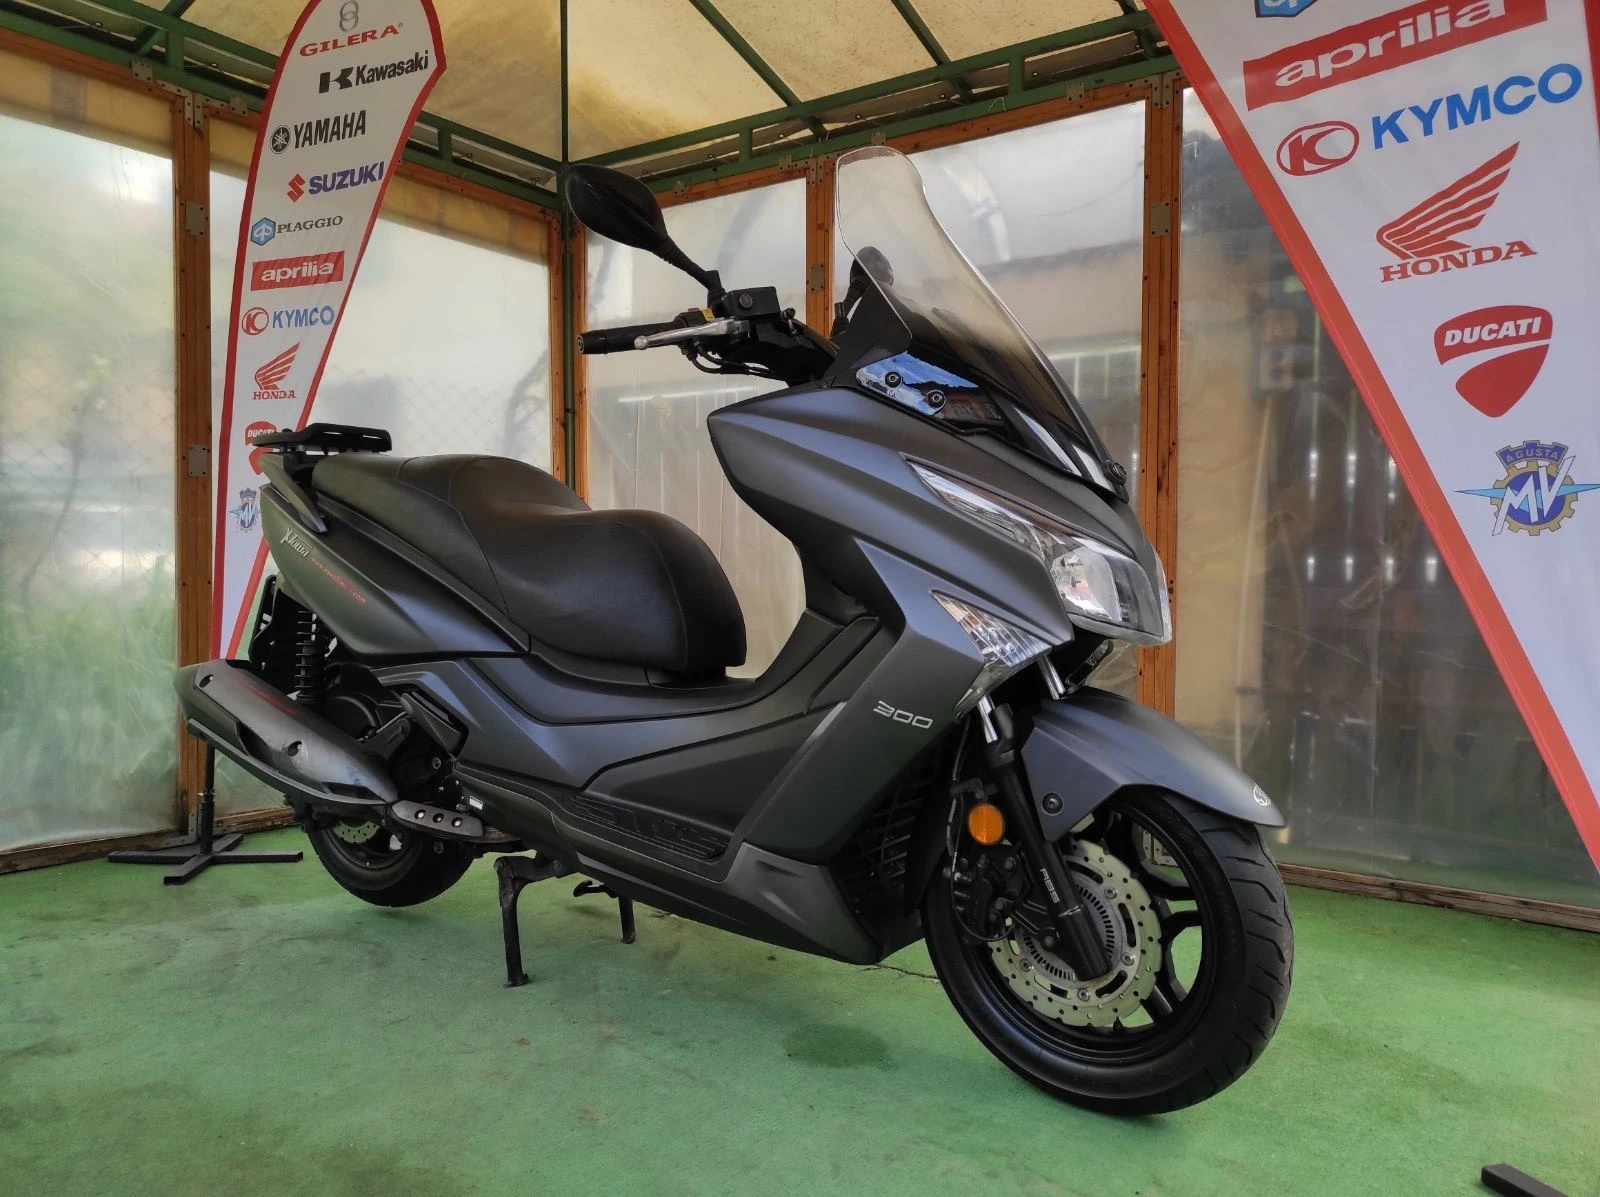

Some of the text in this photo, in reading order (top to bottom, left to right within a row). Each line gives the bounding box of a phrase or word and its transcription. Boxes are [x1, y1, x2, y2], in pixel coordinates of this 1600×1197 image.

[299, 24, 399, 57] GILERA
[1275, 0, 1506, 87] aprilia
[355, 50, 429, 86] Kawasaki
[1372, 63, 1583, 150] KYMCO
[294, 110, 367, 149] YAMAHA
[308, 161, 385, 195] SUZUKI
[277, 215, 344, 234] PIAGGIO
[261, 261, 334, 282] aprilia
[1380, 240, 1538, 283] HONDA
[272, 305, 335, 329] KYMCO
[1443, 316, 1543, 347] DUCATI
[252, 389, 296, 400] HONDA
[1505, 448, 1560, 463] AGUSTA
[1492, 455, 1576, 536] MV
[873, 700, 934, 729] 300
[1039, 868, 1060, 904] ABS
